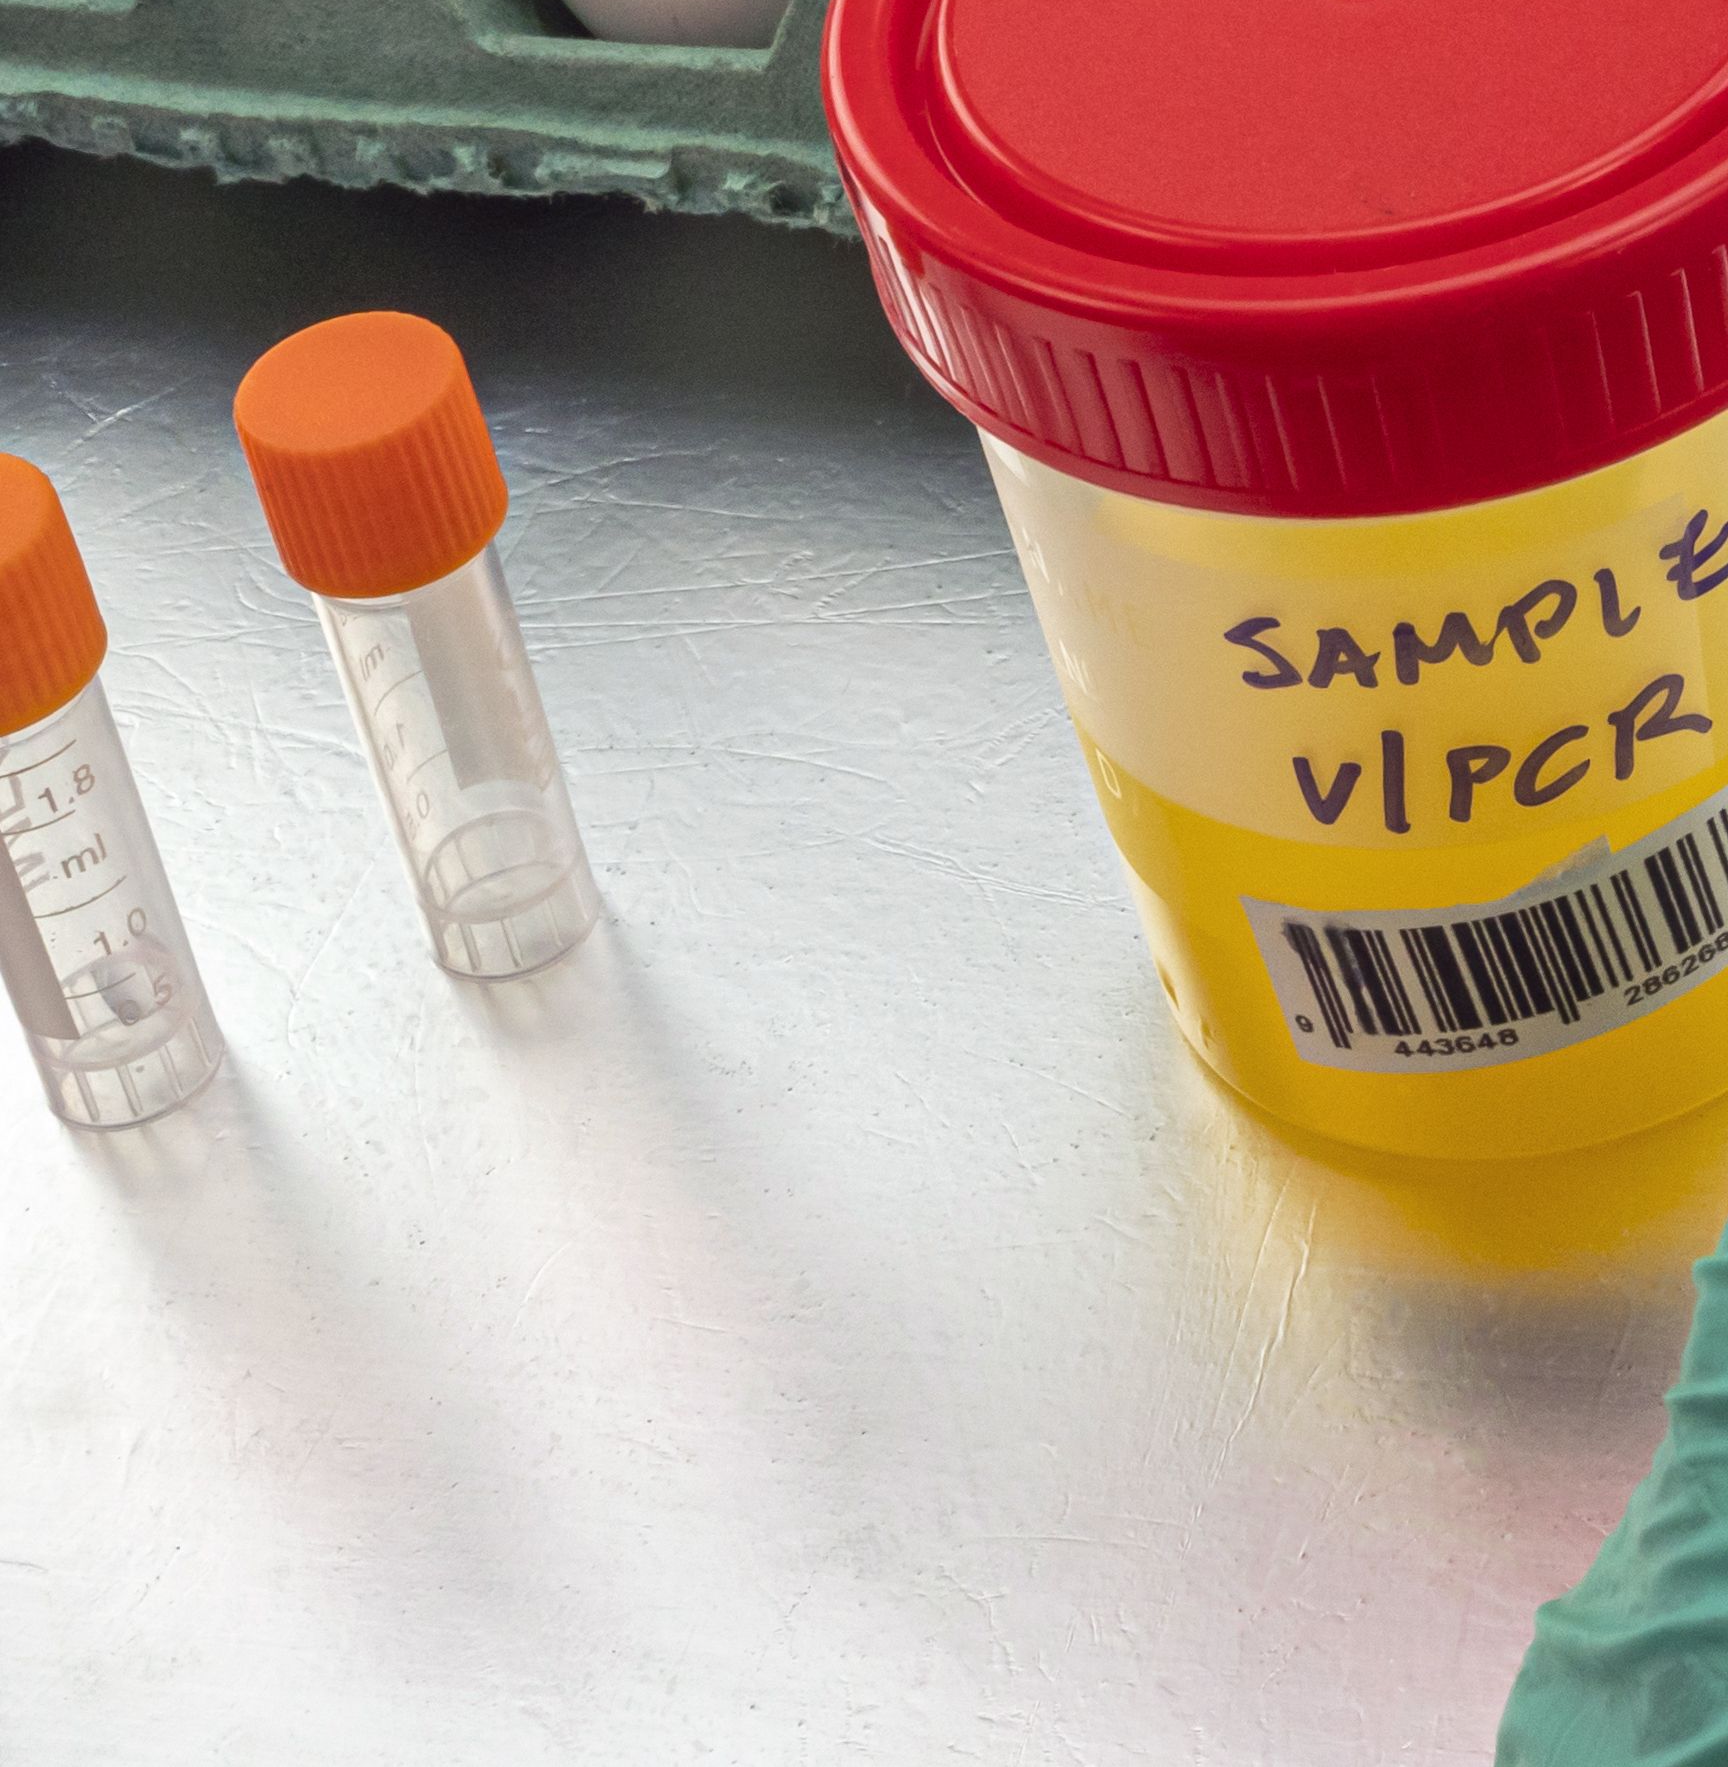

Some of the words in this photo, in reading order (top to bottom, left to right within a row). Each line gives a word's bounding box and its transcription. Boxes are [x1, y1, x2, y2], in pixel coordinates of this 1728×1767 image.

[37, 763, 96, 814] 1.8
[93, 906, 148, 956] 1.0
[1393, 1028, 1520, 1058] 443648
